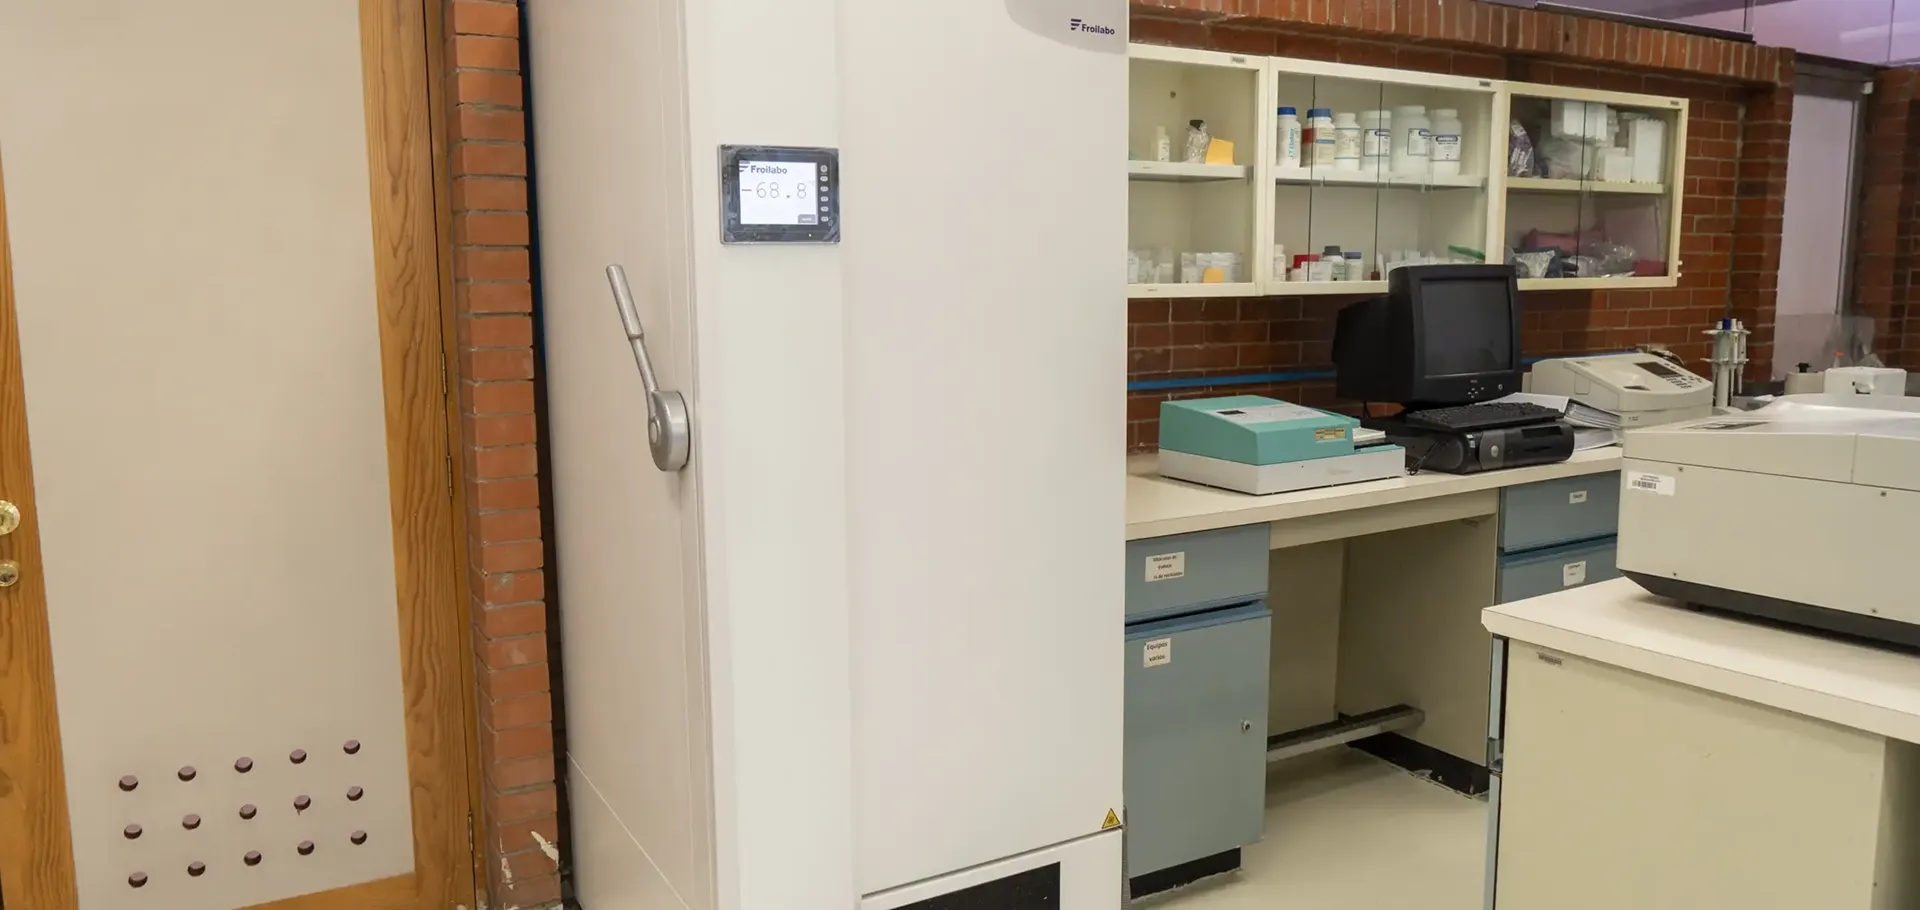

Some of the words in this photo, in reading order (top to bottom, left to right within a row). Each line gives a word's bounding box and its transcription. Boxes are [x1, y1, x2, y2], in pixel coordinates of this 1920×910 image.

[1081, 23, 1115, 35] Froilabo
[750, 165, 788, 174] Froilabo
[1146, 641, 1168, 651] Equipos
